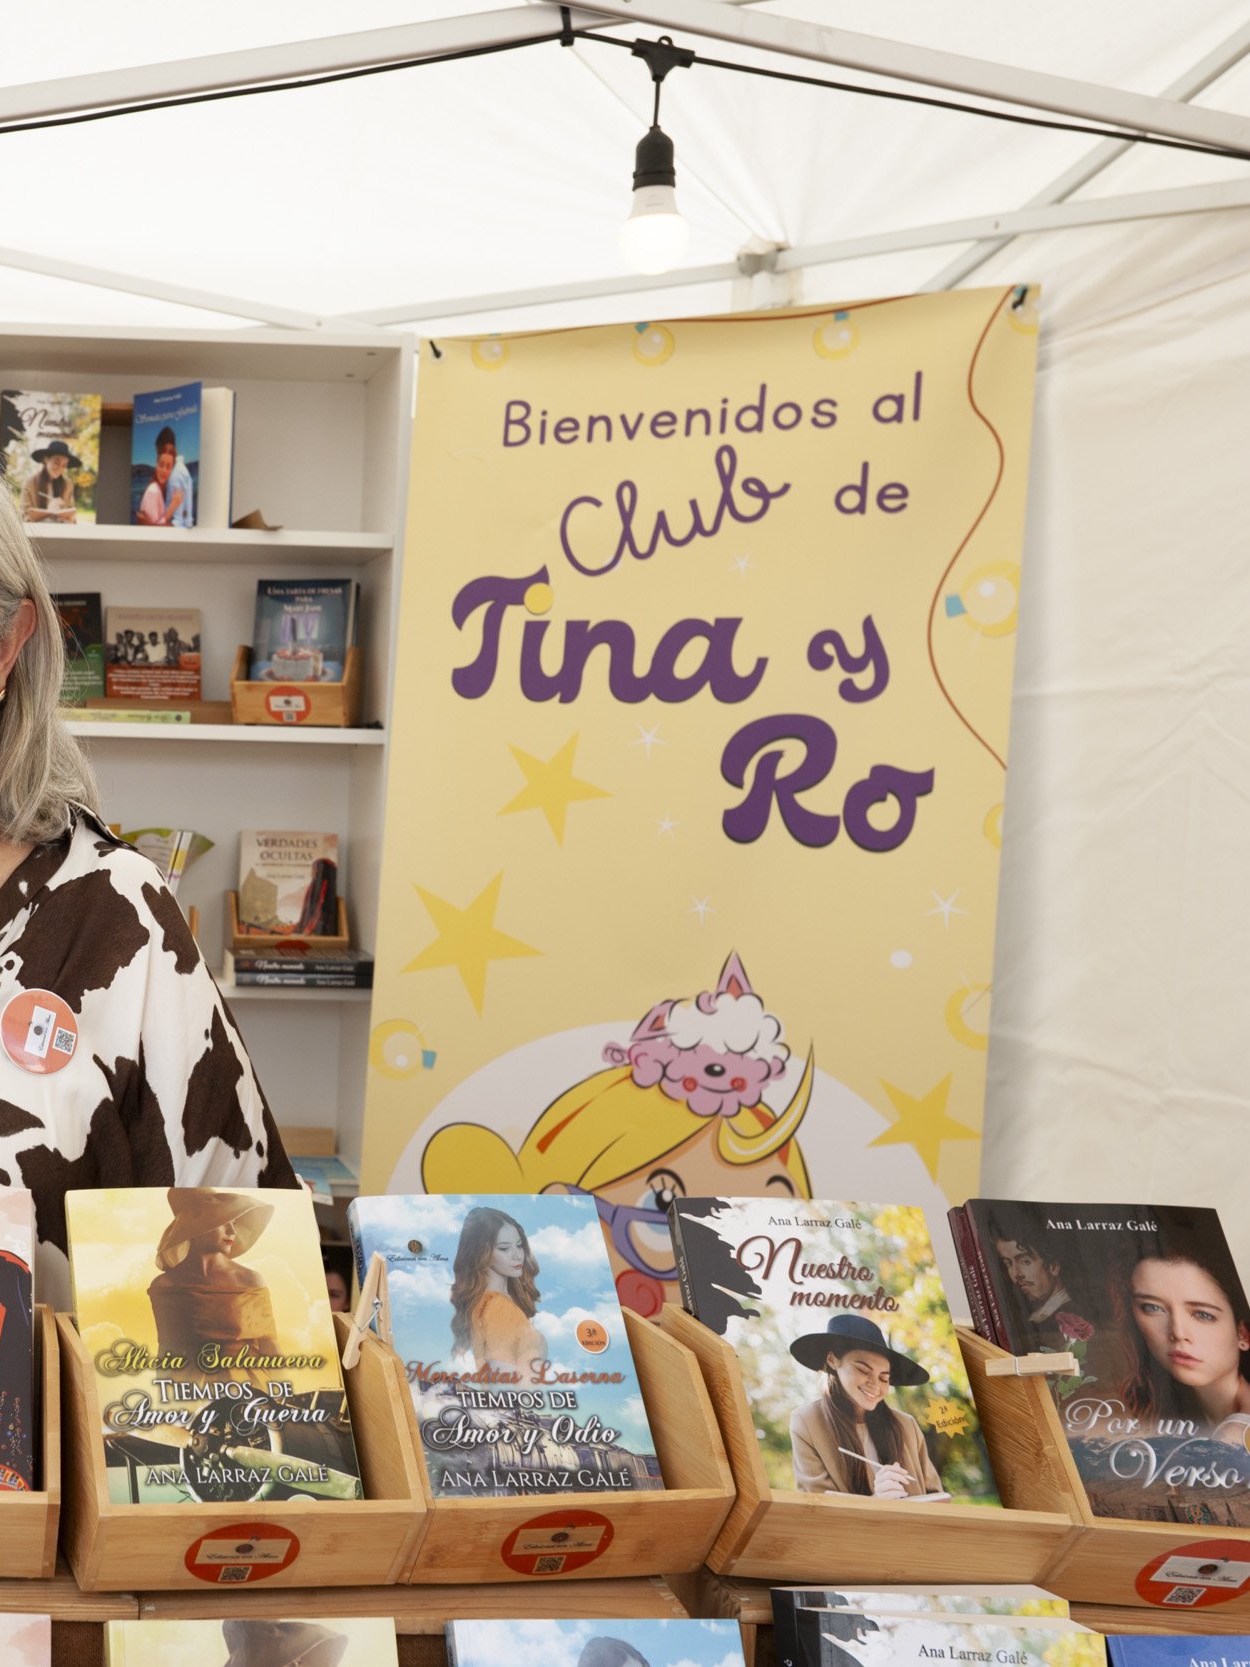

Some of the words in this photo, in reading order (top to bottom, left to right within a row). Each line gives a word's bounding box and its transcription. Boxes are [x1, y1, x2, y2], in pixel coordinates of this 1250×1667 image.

[502, 383, 838, 447] Bienvenidos
[872, 370, 923, 424] al
[560, 444, 791, 576] Club
[834, 461, 910, 515] de
[451, 564, 769, 704] Tina
[807, 614, 890, 704] y
[720, 713, 935, 853] Ro
[256, 838, 318, 848] VERDADES
[260, 851, 313, 860] OCULTAS
[768, 1216, 791, 1226] Ana
[795, 1216, 832, 1229] Larraz
[835, 1217, 862, 1230] Galé
[1046, 1219, 1072, 1230] Ana
[1076, 1219, 1122, 1231] Larraz
[1126, 1219, 1157, 1232] Galé
[736, 1235, 874, 1286] Nuestro
[789, 1286, 900, 1311] momento
[95, 1340, 187, 1377] Alicia
[198, 1342, 326, 1374] Salanueva
[405, 1360, 522, 1384] Merceditas
[530, 1358, 625, 1384] Laserna
[153, 1379, 252, 1402] TIEMPOS
[268, 1382, 293, 1398] DE
[457, 1391, 544, 1408] TIEMPOS
[550, 1392, 577, 1408] DE
[104, 1390, 194, 1431] Amor
[201, 1409, 219, 1434] y
[230, 1397, 331, 1436] Guerra
[936, 1416, 965, 1428] Edición
[1065, 1398, 1140, 1433] Por
[1157, 1417, 1199, 1437] un
[422, 1407, 516, 1450] Amor
[518, 1427, 541, 1454] y
[551, 1415, 619, 1444] Odio
[145, 1467, 190, 1485] ANA
[197, 1466, 274, 1484] LARRAZ
[278, 1463, 328, 1483] GALÉ
[441, 1470, 487, 1487] ANA
[492, 1470, 572, 1487] LARRAZ
[578, 1467, 631, 1487] GALÉ
[918, 1644, 945, 1658] Ana
[949, 1646, 993, 1662] Larraz
[996, 1648, 1028, 1665] Galé
